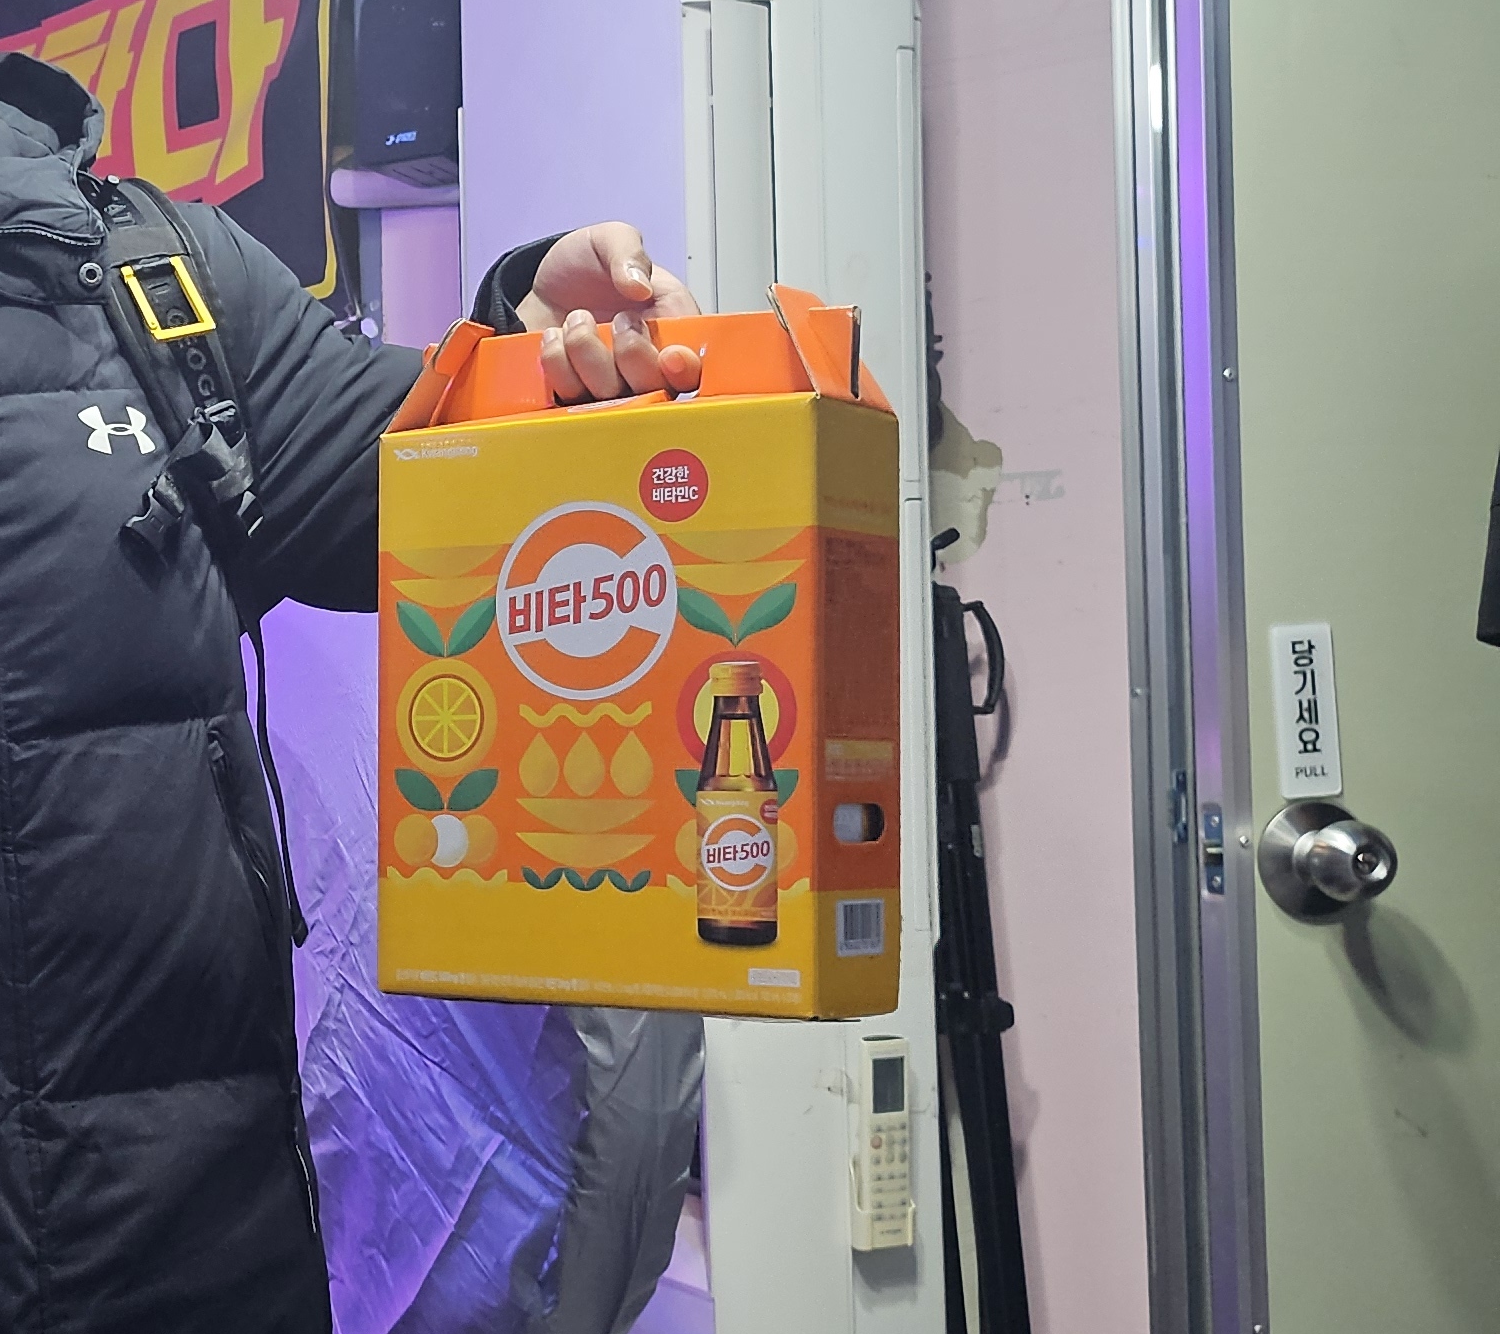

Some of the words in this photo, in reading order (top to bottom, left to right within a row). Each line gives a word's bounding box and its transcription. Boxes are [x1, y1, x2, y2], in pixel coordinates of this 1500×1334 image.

[652, 466, 690, 484] 건강한
[652, 486, 699, 504] 비타민C
[507, 563, 668, 637] 비타500
[1290, 639, 1322, 755] 당기세요
[1295, 765, 1328, 778] PULL
[706, 840, 770, 864] 비타500
